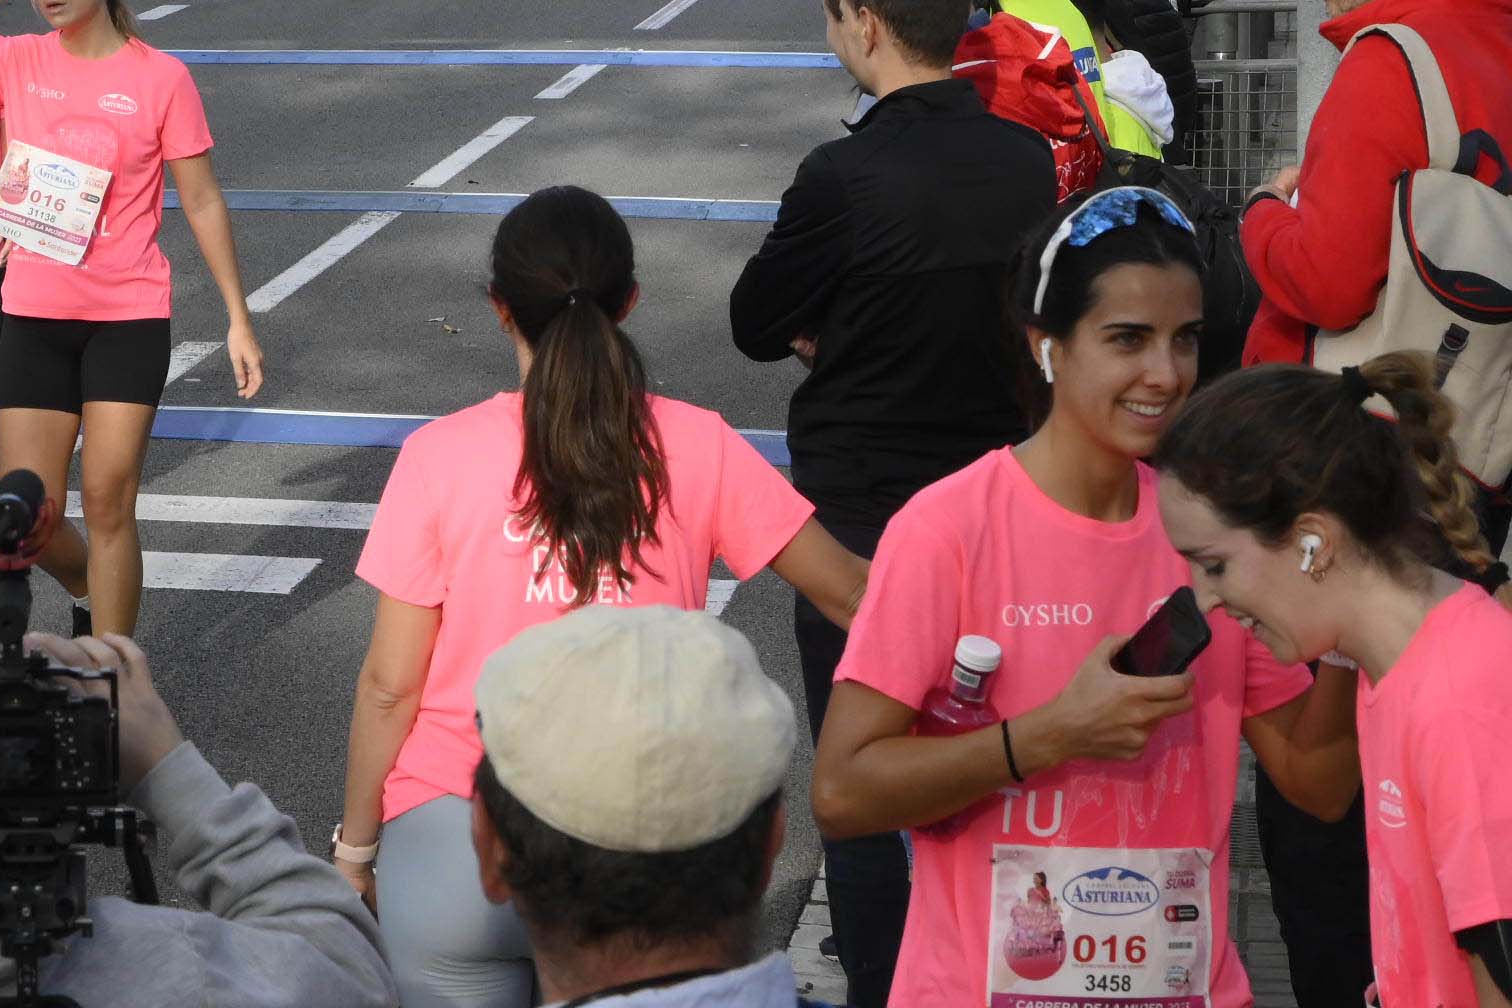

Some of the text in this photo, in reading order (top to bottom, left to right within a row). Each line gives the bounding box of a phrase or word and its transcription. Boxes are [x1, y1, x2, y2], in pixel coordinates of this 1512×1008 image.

[29, 189, 67, 212] 016
[27, 207, 56, 224] 31138
[26, 219, 35, 228] DE
[36, 222, 45, 232] LA
[44, 225, 67, 238] MUJER
[524, 576, 633, 604] MUER
[1001, 602, 1094, 628] OYSHO
[999, 788, 1064, 838] TU
[1071, 884, 1152, 905] ASTURIANA
[1165, 878, 1196, 890] SUMA
[1072, 934, 1147, 964] 016
[1084, 974, 1132, 992] 3458
